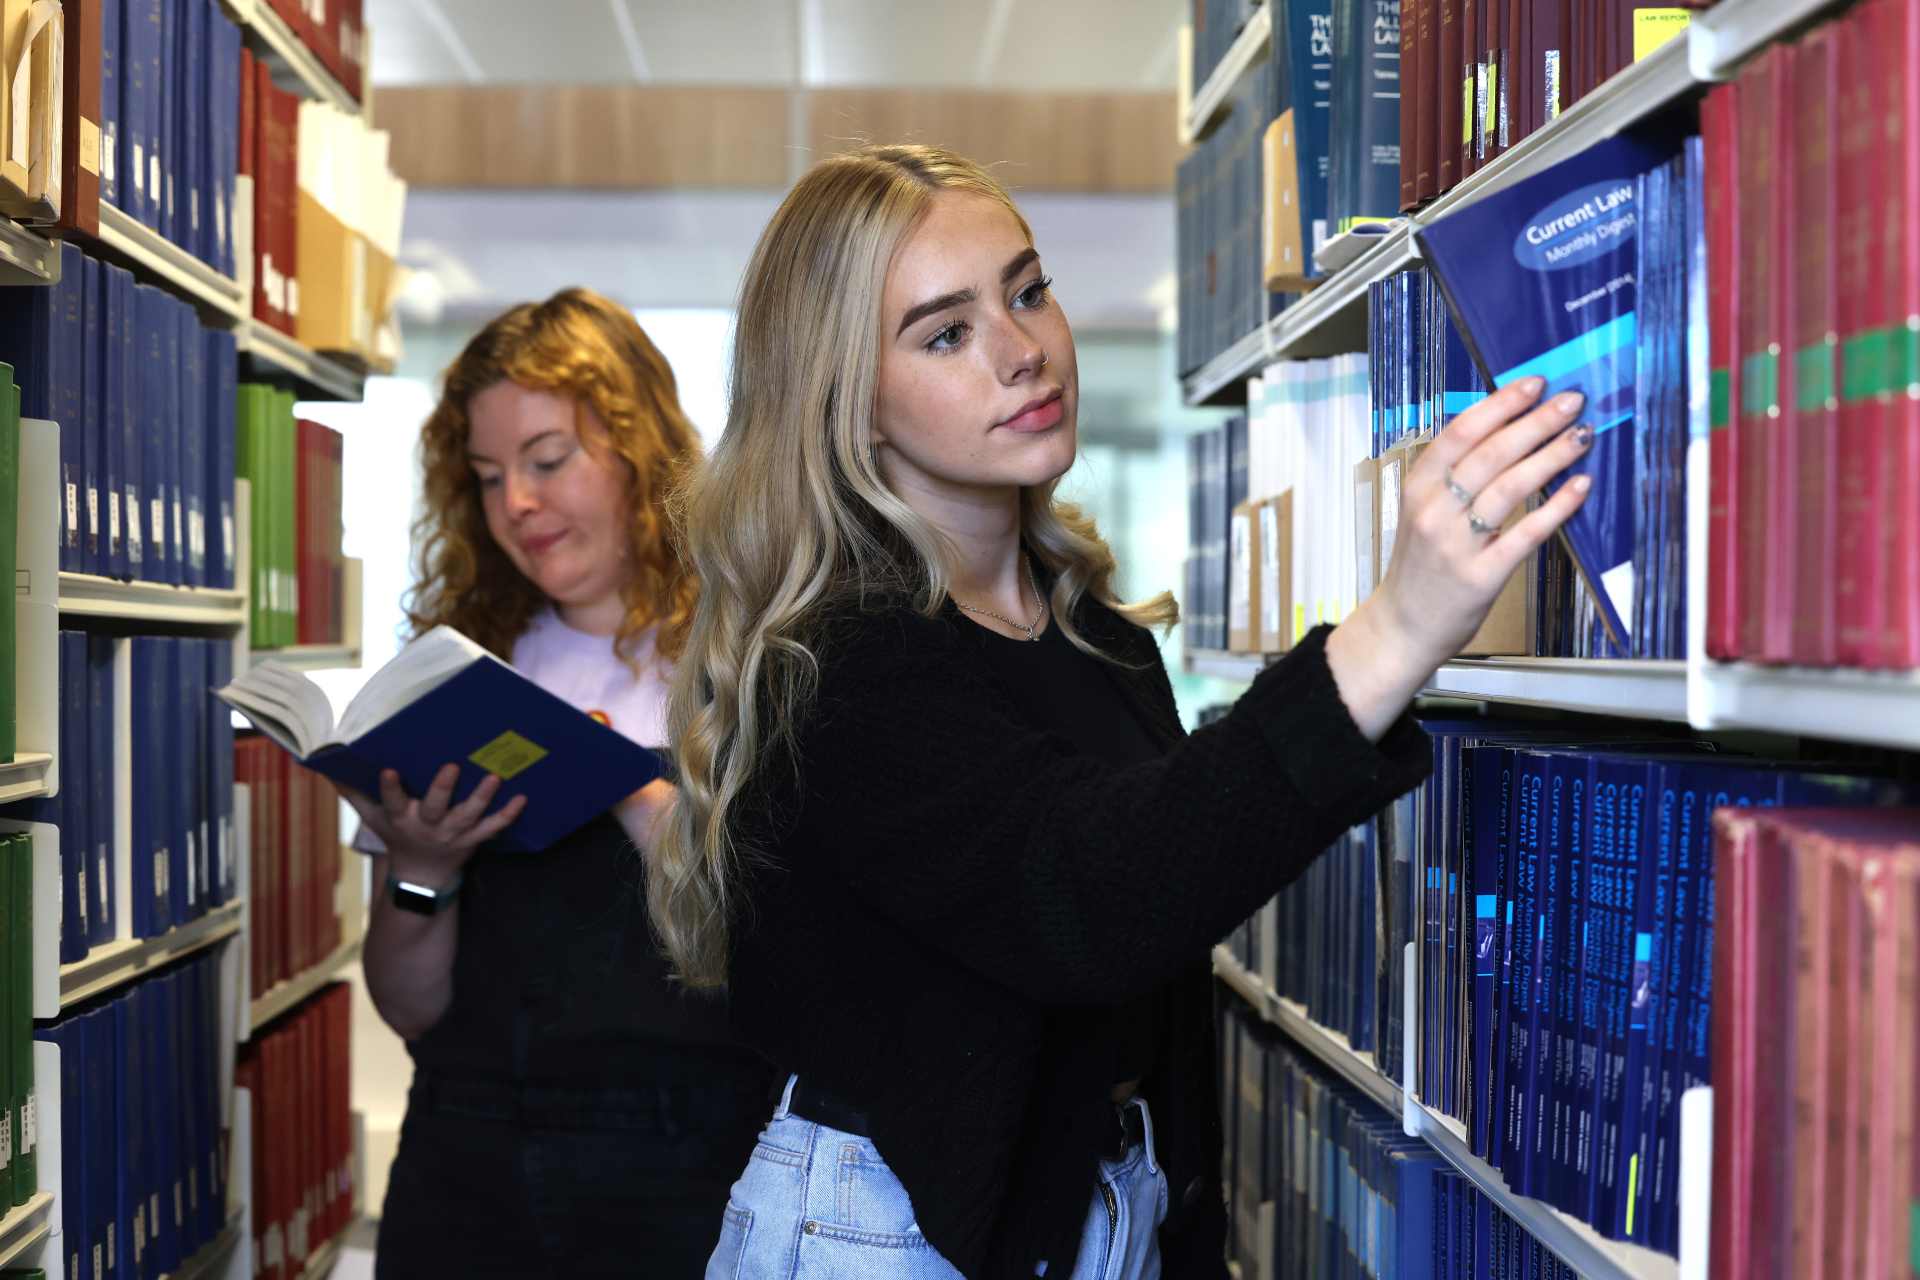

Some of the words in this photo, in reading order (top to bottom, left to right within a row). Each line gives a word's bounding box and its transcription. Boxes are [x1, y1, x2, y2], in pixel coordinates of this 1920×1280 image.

[1311, 40, 1333, 56] LA
[1526, 202, 1597, 245] Current
[1594, 185, 1632, 212] Law
[1545, 232, 1598, 264] Monthly
[1519, 774, 1530, 848] Current
[1529, 777, 1541, 849] Current
[1550, 776, 1562, 847] Current
[1571, 779, 1583, 853] Current
[1627, 783, 1643, 862] Current
[1659, 789, 1676, 866] Current
[1679, 790, 1696, 868] Current
[1517, 851, 1526, 887] Law
[1526, 855, 1537, 893] Law
[1547, 853, 1559, 892] Law
[1569, 859, 1580, 898] Law
[1625, 867, 1638, 910] Law
[1655, 874, 1669, 916] Law
[1675, 875, 1689, 918] Law
[1522, 897, 1535, 960] Monthly
[1544, 897, 1555, 961] Monthly
[1519, 965, 1531, 1012] Digest
